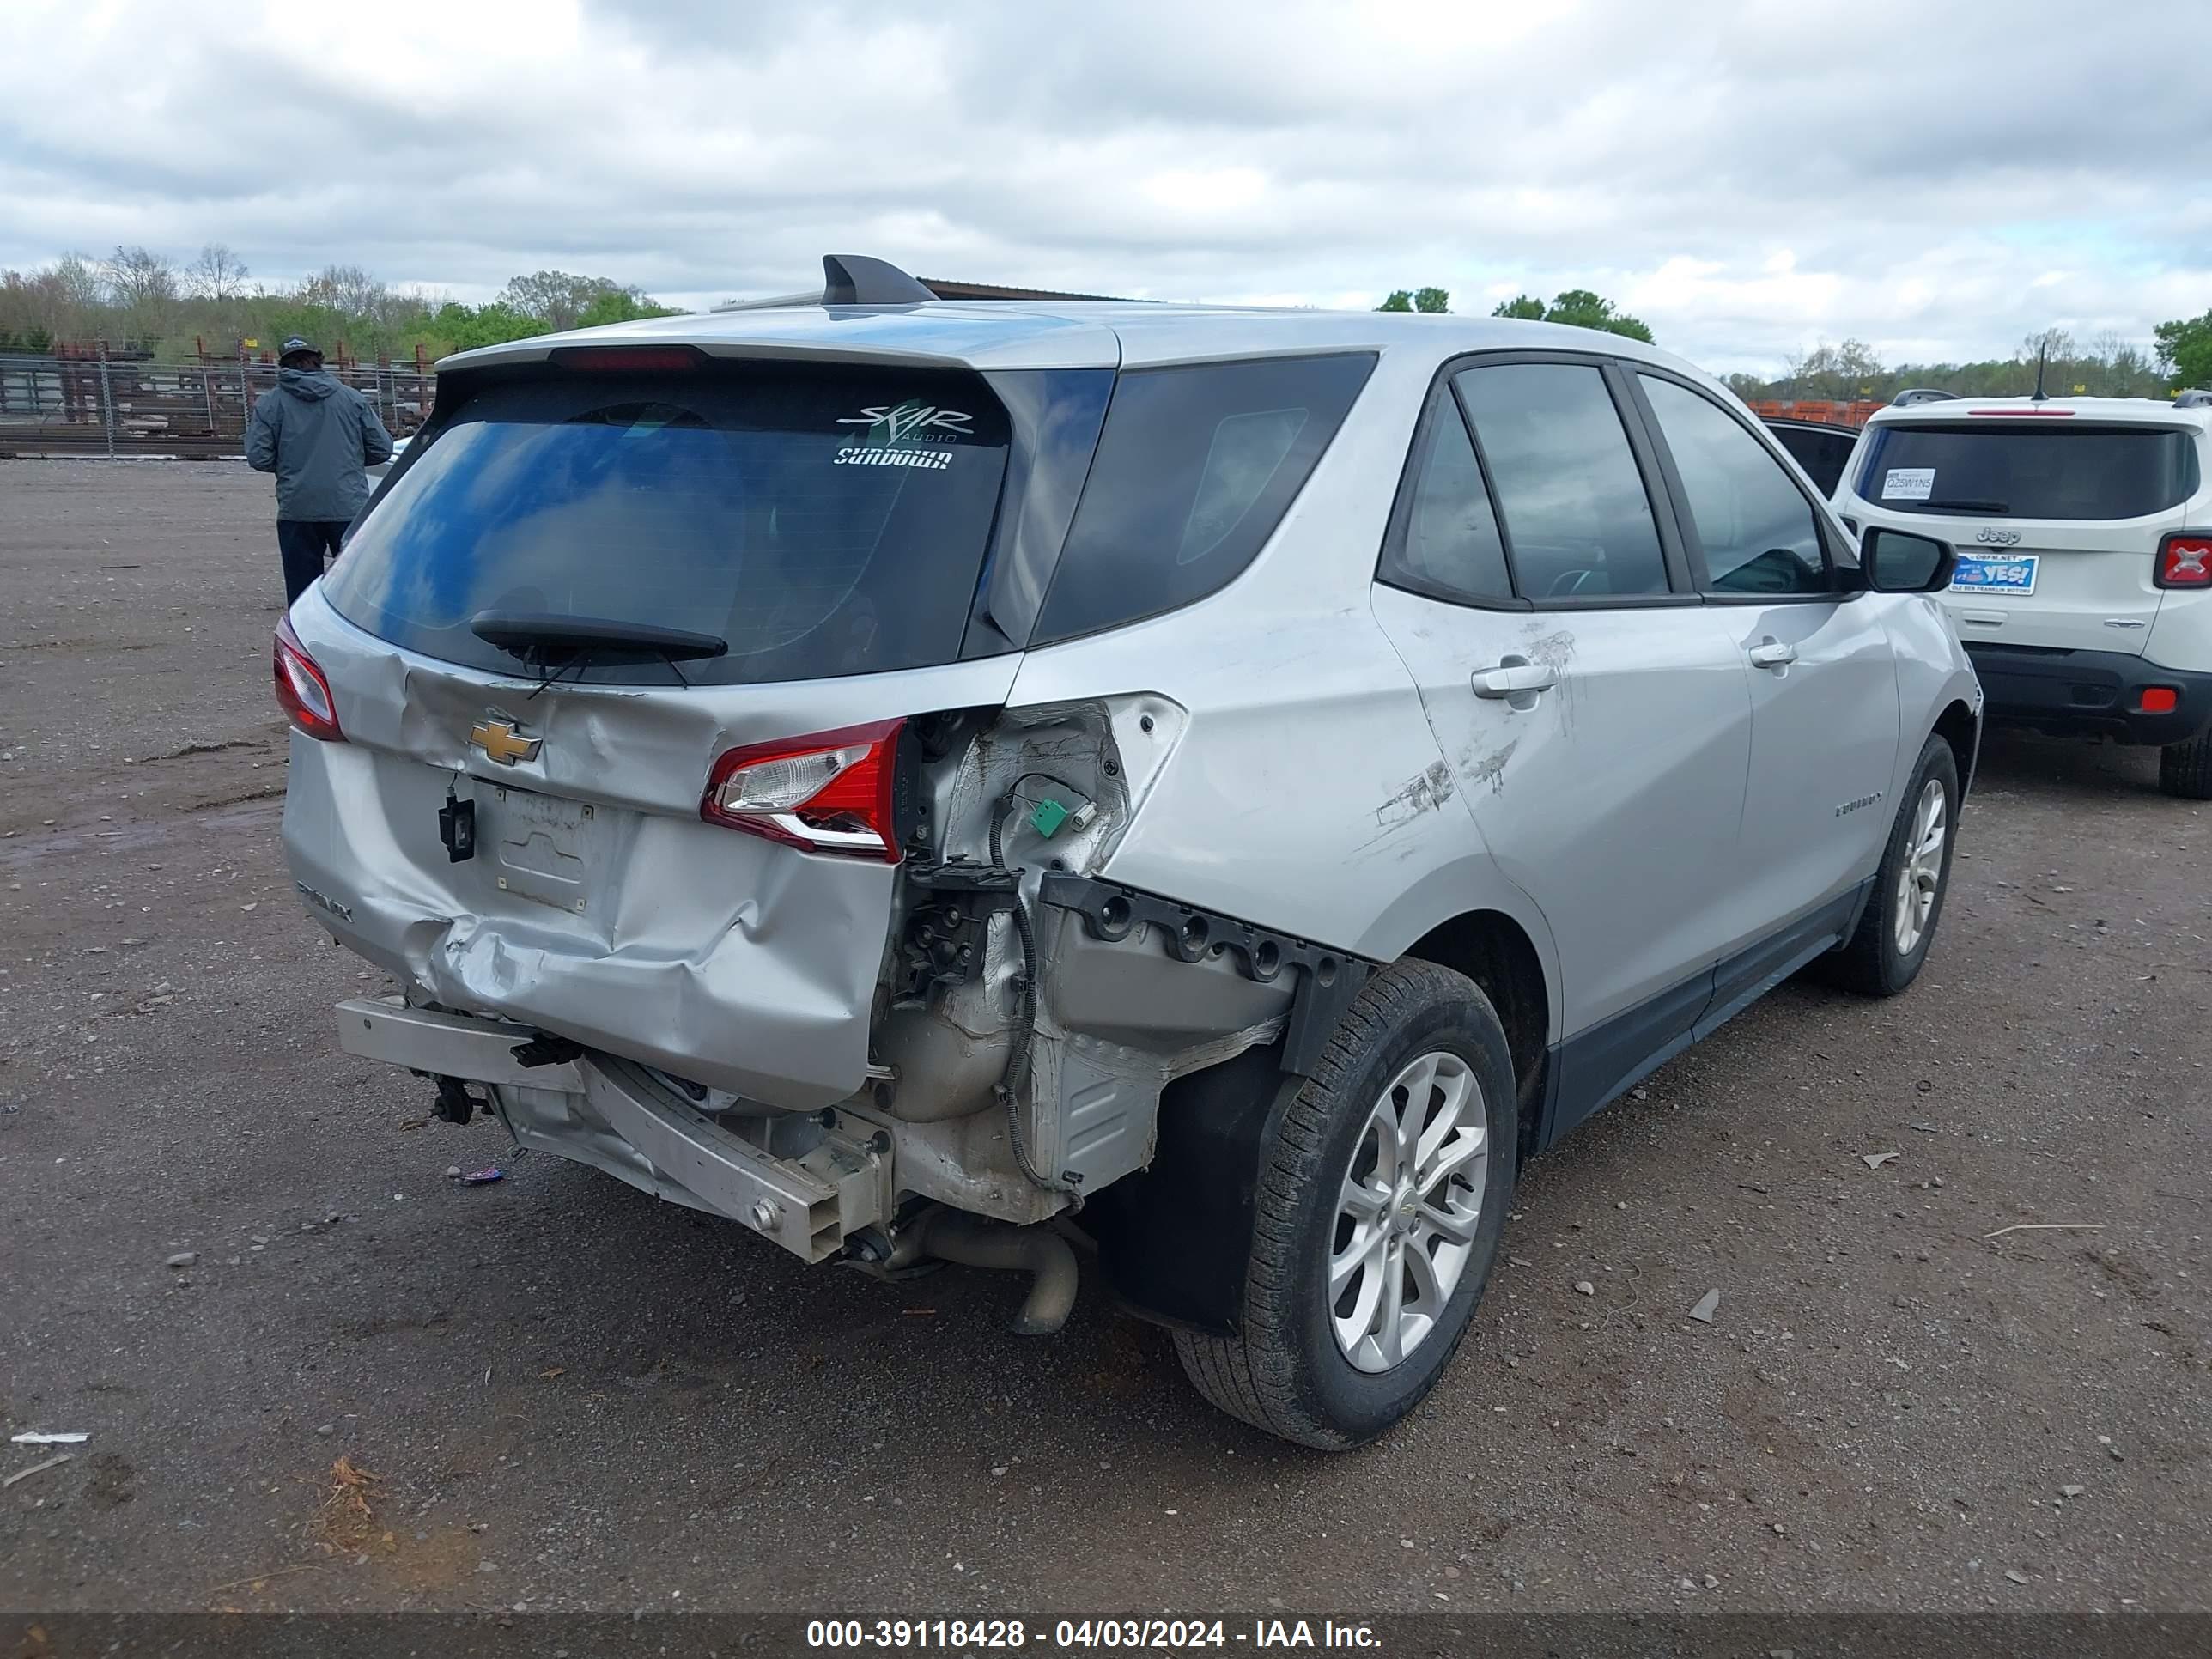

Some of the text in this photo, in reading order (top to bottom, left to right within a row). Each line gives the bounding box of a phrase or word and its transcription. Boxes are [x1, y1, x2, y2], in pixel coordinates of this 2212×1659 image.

[902, 432, 957, 443] AUDIO
[834, 447, 953, 470] SUNDOWN
[1977, 527, 2021, 546] Jeep
[1984, 565, 2030, 584] YES!
